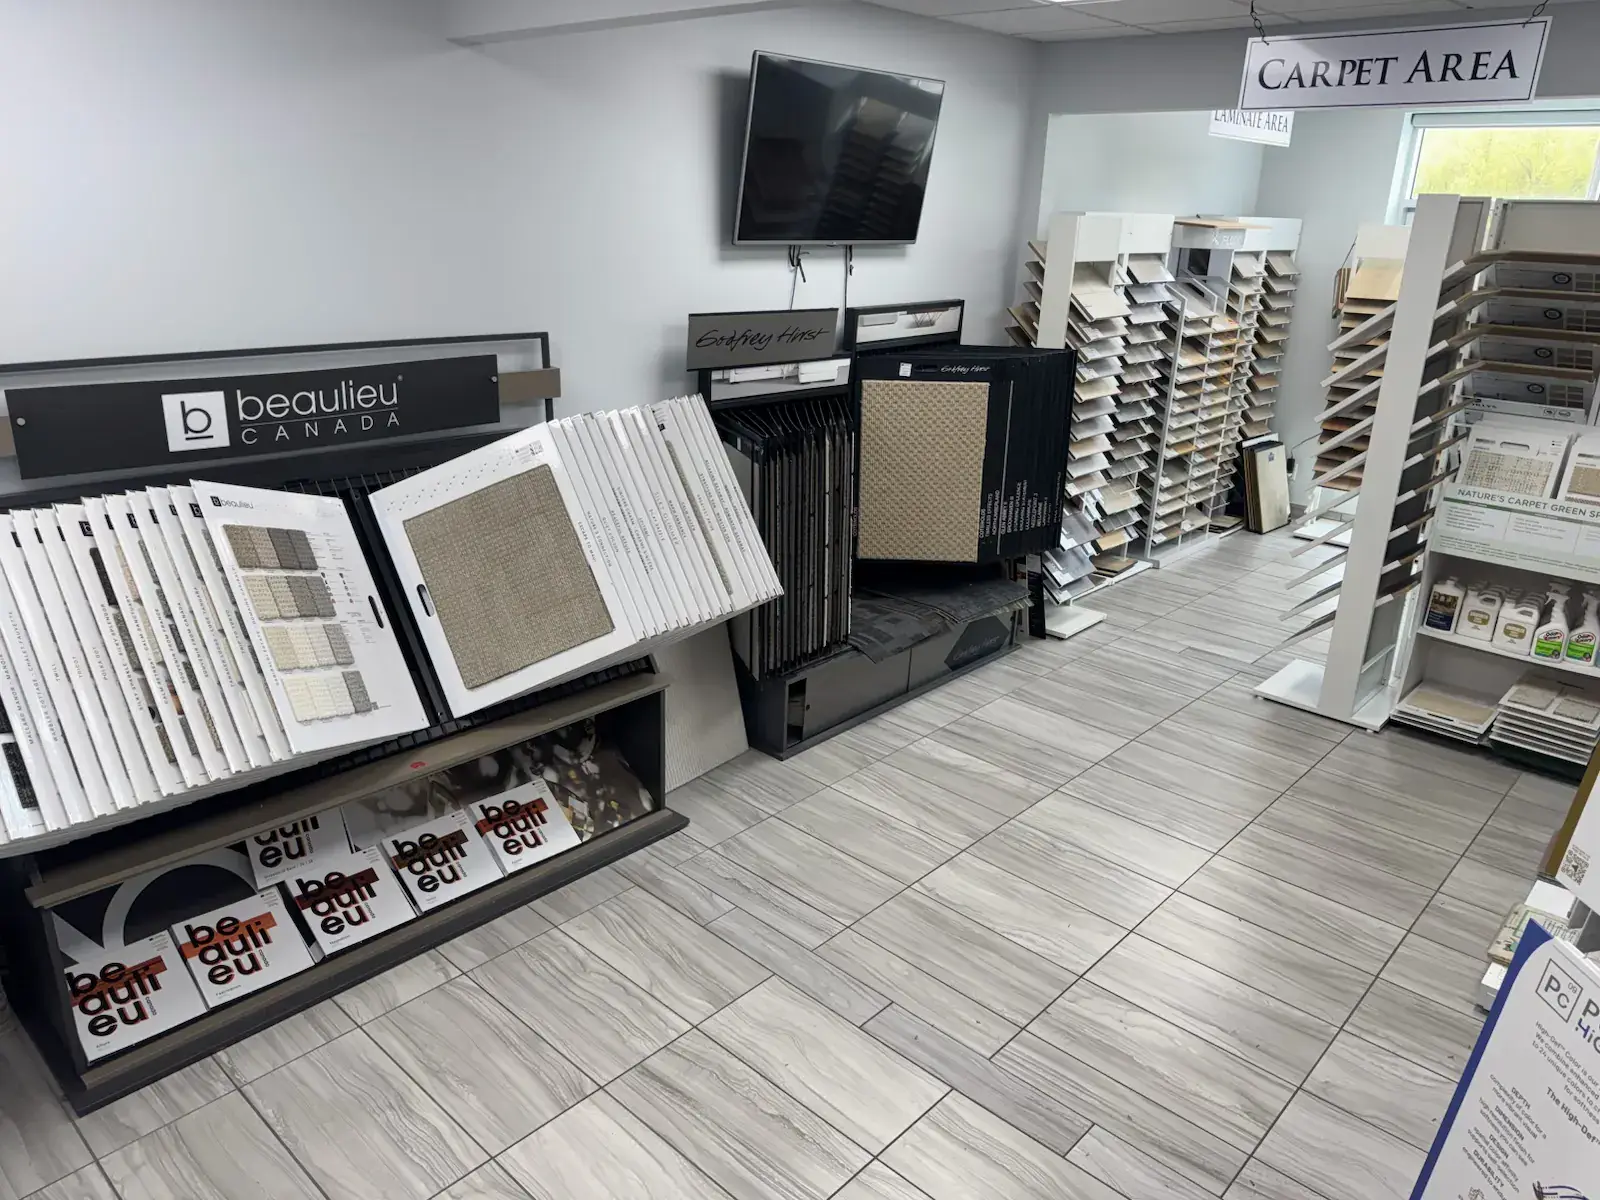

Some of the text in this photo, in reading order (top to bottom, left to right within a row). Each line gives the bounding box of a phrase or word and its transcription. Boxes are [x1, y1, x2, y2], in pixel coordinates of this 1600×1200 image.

[1258, 49, 1520, 90] CARPET AREA
[1264, 112, 1288, 132] AREA
[696, 326, 830, 350] Godfrey Hirst
[237, 380, 398, 420] beaulieu
[242, 412, 399, 444] CANADA
[1458, 489, 1505, 502] NATURE'S
[1508, 496, 1548, 510] CARPET
[1550, 504, 1586, 517] GREEN
[101, 602, 116, 636] SPLENDOR
[124, 594, 141, 631] SANCTUARY
[114, 637, 123, 655] SILKY
[139, 633, 149, 650] CALM
[155, 607, 186, 683] SOUVENIR FROM FRANCE
[178, 601, 208, 677] SOUVENIR FROM CANADA
[123, 662, 136, 690] SPARKLE
[11, 686, 22, 710] MANOR
[33, 678, 46, 708] COTTAGE
[160, 686, 169, 703] CALM
[479, 800, 520, 824] be
[493, 804, 548, 839] auli
[260, 837, 306, 868] eu
[392, 833, 437, 857] be
[408, 837, 467, 875] auli
[503, 830, 543, 855] eu
[296, 872, 346, 897] be
[418, 865, 461, 892] eu
[311, 876, 377, 916] auli
[184, 917, 240, 948] be
[321, 905, 369, 935] eu
[199, 921, 272, 965] auli
[65, 963, 126, 997] be
[208, 953, 262, 984] eu
[79, 966, 161, 1015] auli
[88, 1001, 149, 1036] eu
[1532, 1041, 1539, 1049] to
[1539, 1047, 1547, 1057] 24
[1547, 1056, 1566, 1078] unique
[1567, 1077, 1586, 1098] colors
[1587, 1097, 1593, 1105] to
[1536, 1032, 1600, 1100] We combine enhanced
[1565, 1051, 1581, 1069] Color
[1581, 1068, 1587, 1076] is
[1588, 1076, 1599, 1087] our
[1512, 1087, 1530, 1110] DEPTH
[1547, 1087, 1560, 1106] The
[1564, 1085, 1600, 1124] for softness
[1495, 1105, 1524, 1140] DIMENSION
[1522, 1110, 1535, 1126] color
[1535, 1124, 1543, 1133] for
[1489, 1134, 1509, 1159] DESIGN
[1473, 1150, 1504, 1187] DURABILITY
